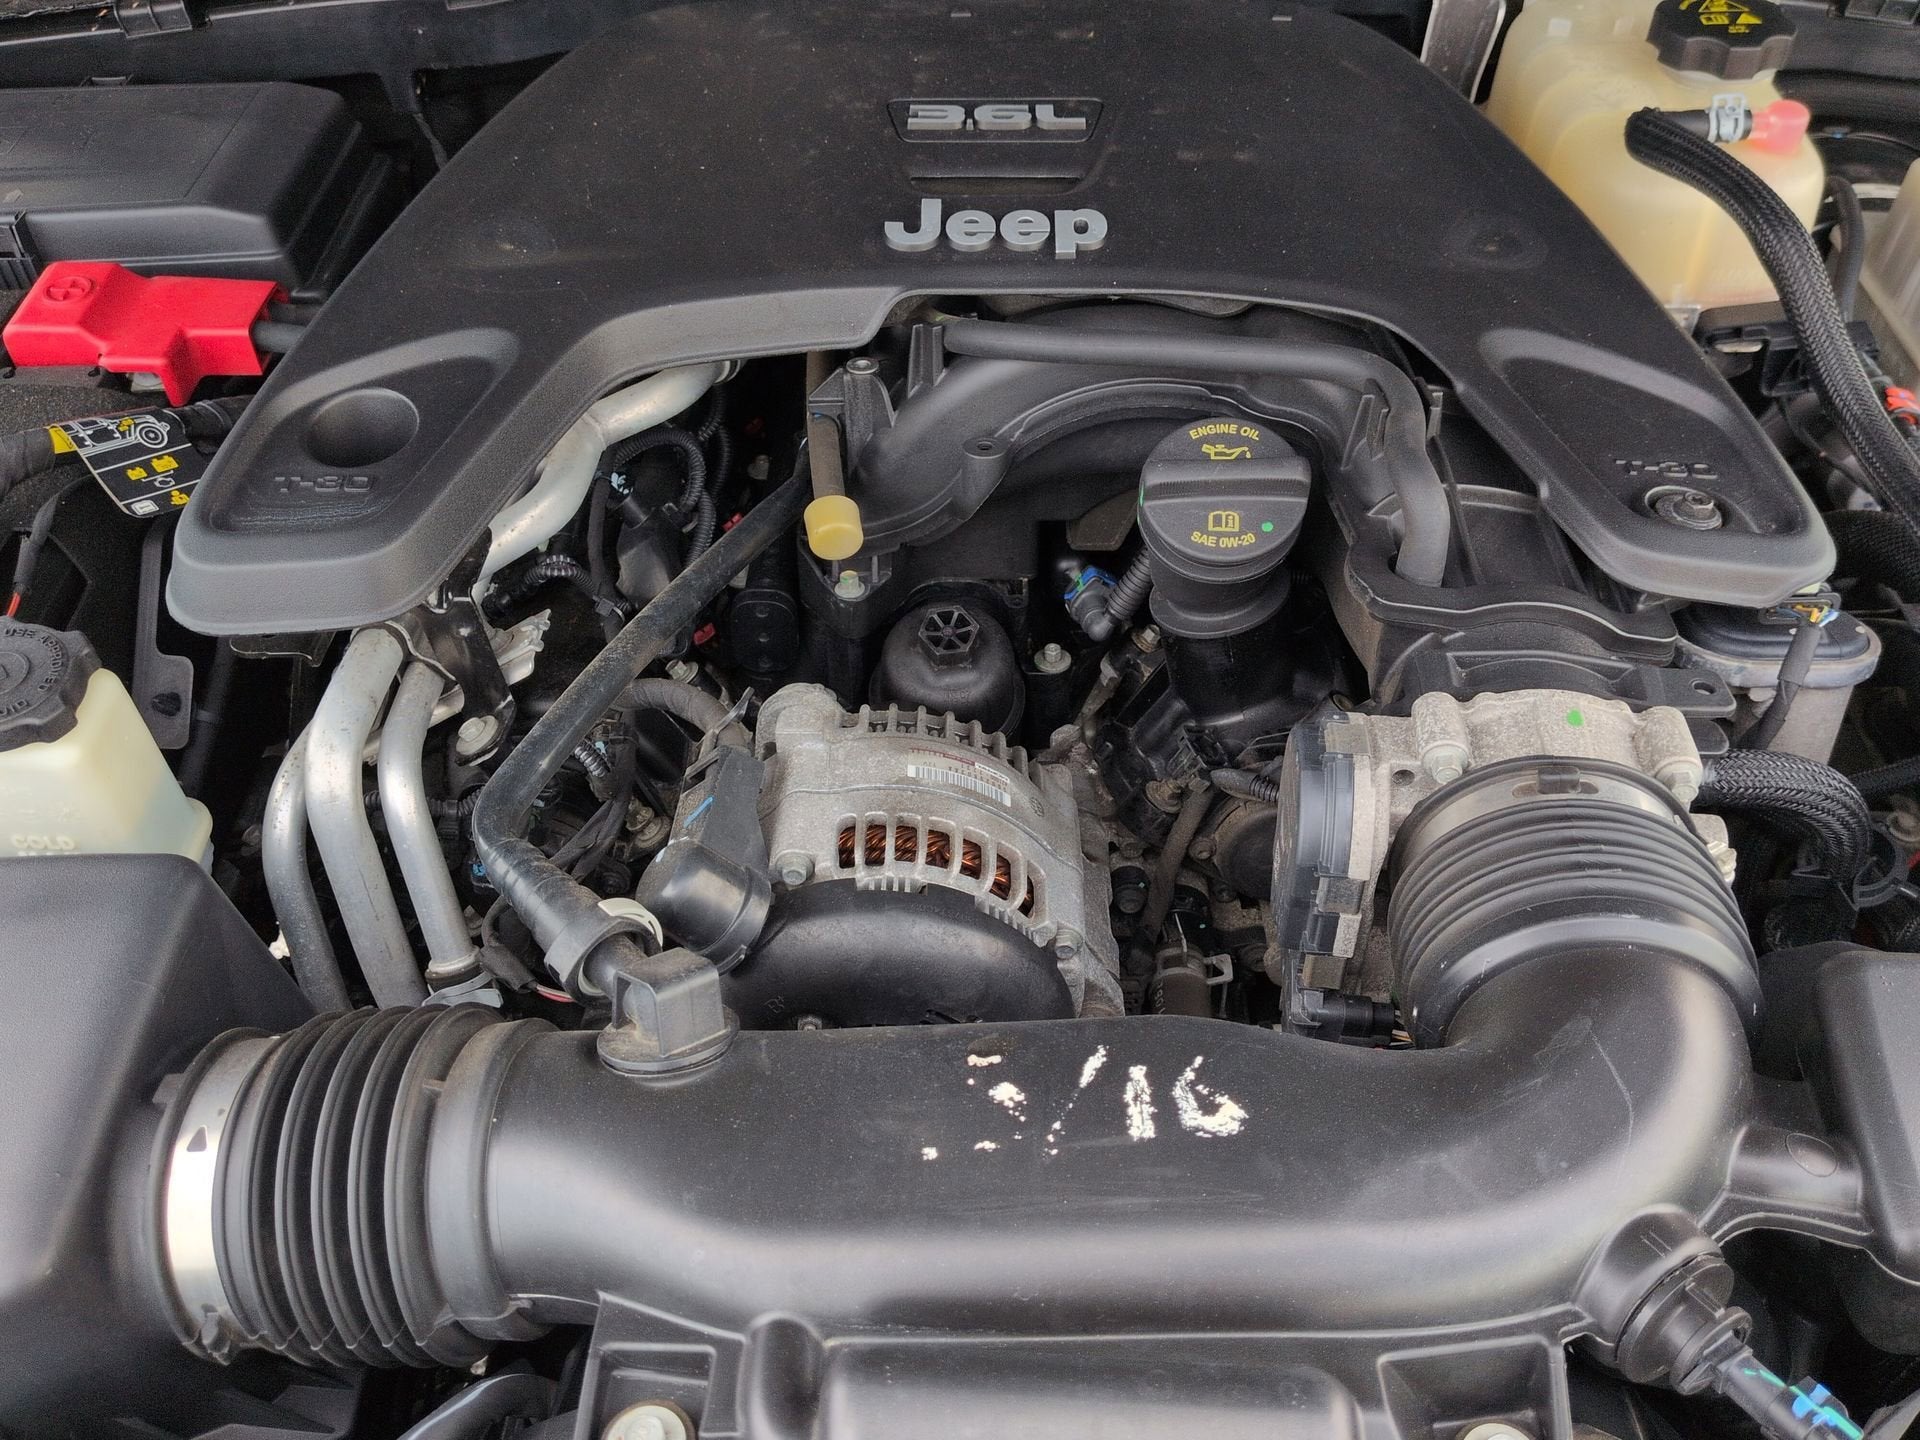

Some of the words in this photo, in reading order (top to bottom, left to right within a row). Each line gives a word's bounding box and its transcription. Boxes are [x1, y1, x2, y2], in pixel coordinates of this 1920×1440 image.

[907, 104, 1087, 131] 3.6L
[884, 198, 1108, 260] Jeep
[1189, 424, 1238, 440] ENGINE
[1240, 426, 1260, 441] OIL
[1614, 459, 1719, 480] T-30
[274, 475, 371, 493] T-30
[1190, 531, 1217, 547] SAE
[1219, 533, 1256, 548] 0W-20
[4, 627, 37, 639] USE
[11, 834, 76, 851] COLD
